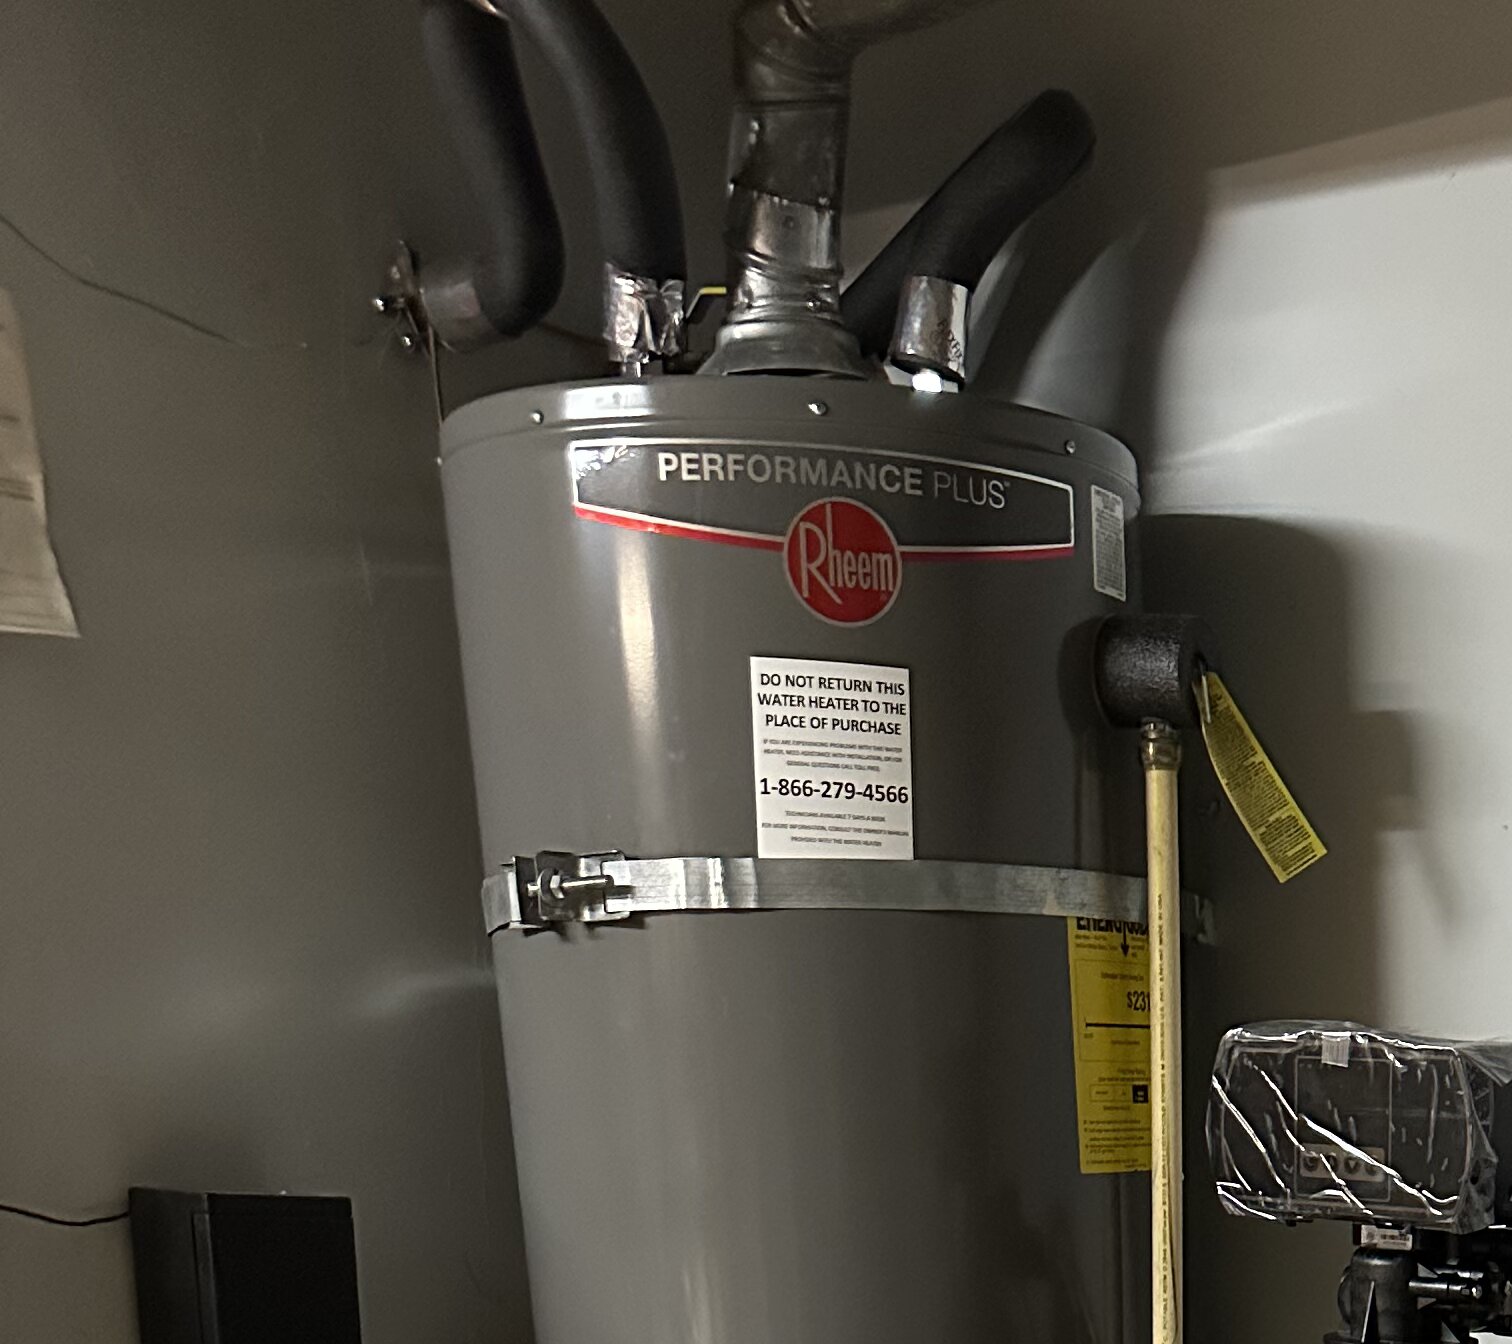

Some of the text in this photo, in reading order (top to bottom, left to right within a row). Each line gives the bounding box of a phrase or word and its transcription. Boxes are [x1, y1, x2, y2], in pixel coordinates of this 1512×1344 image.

[657, 451, 923, 496] PERFORMANCE
[799, 503, 895, 605] Rheem
[760, 673, 905, 696] DO NOT RETURN THIS
[758, 693, 907, 715] WATER HEATER TO THE
[765, 713, 902, 736] PLACE OF PURCHASE
[760, 777, 909, 804] 1-866-279-4566
